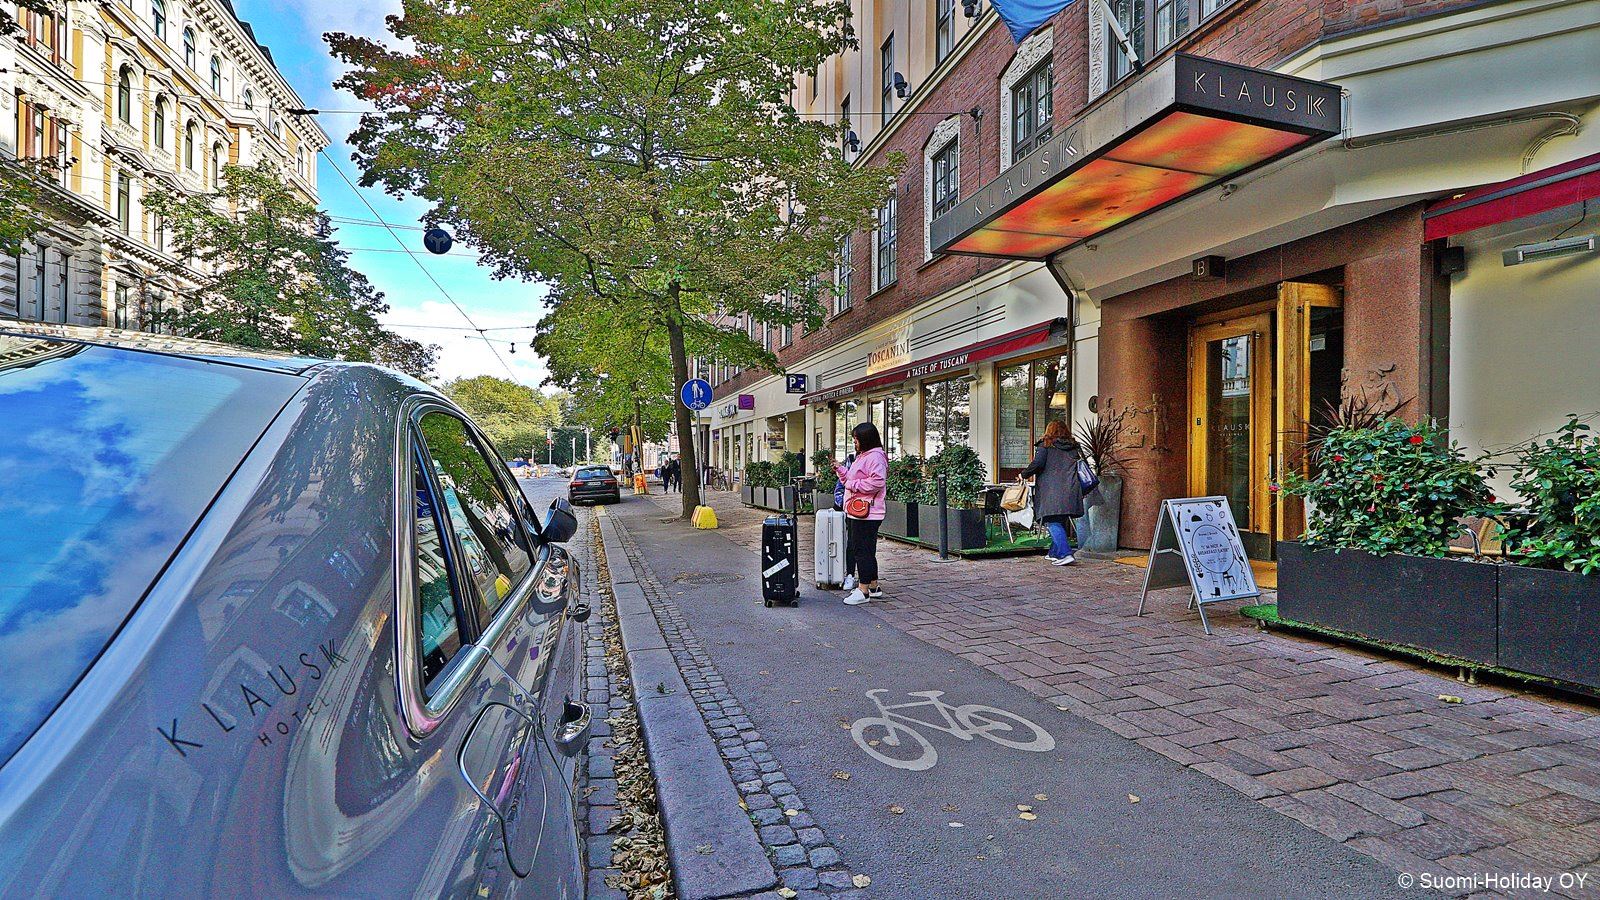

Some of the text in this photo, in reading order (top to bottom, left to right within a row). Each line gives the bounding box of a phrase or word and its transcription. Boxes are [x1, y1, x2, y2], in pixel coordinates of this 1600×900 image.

[1197, 260, 1205, 276] B
[867, 338, 910, 367] TOSCANINI
[906, 370, 911, 378] A
[912, 363, 928, 376] TASTE
[929, 361, 938, 372] OF
[940, 353, 969, 370] TUSCANY
[789, 377, 797, 388] P
[258, 696, 330, 747] HOTEL
